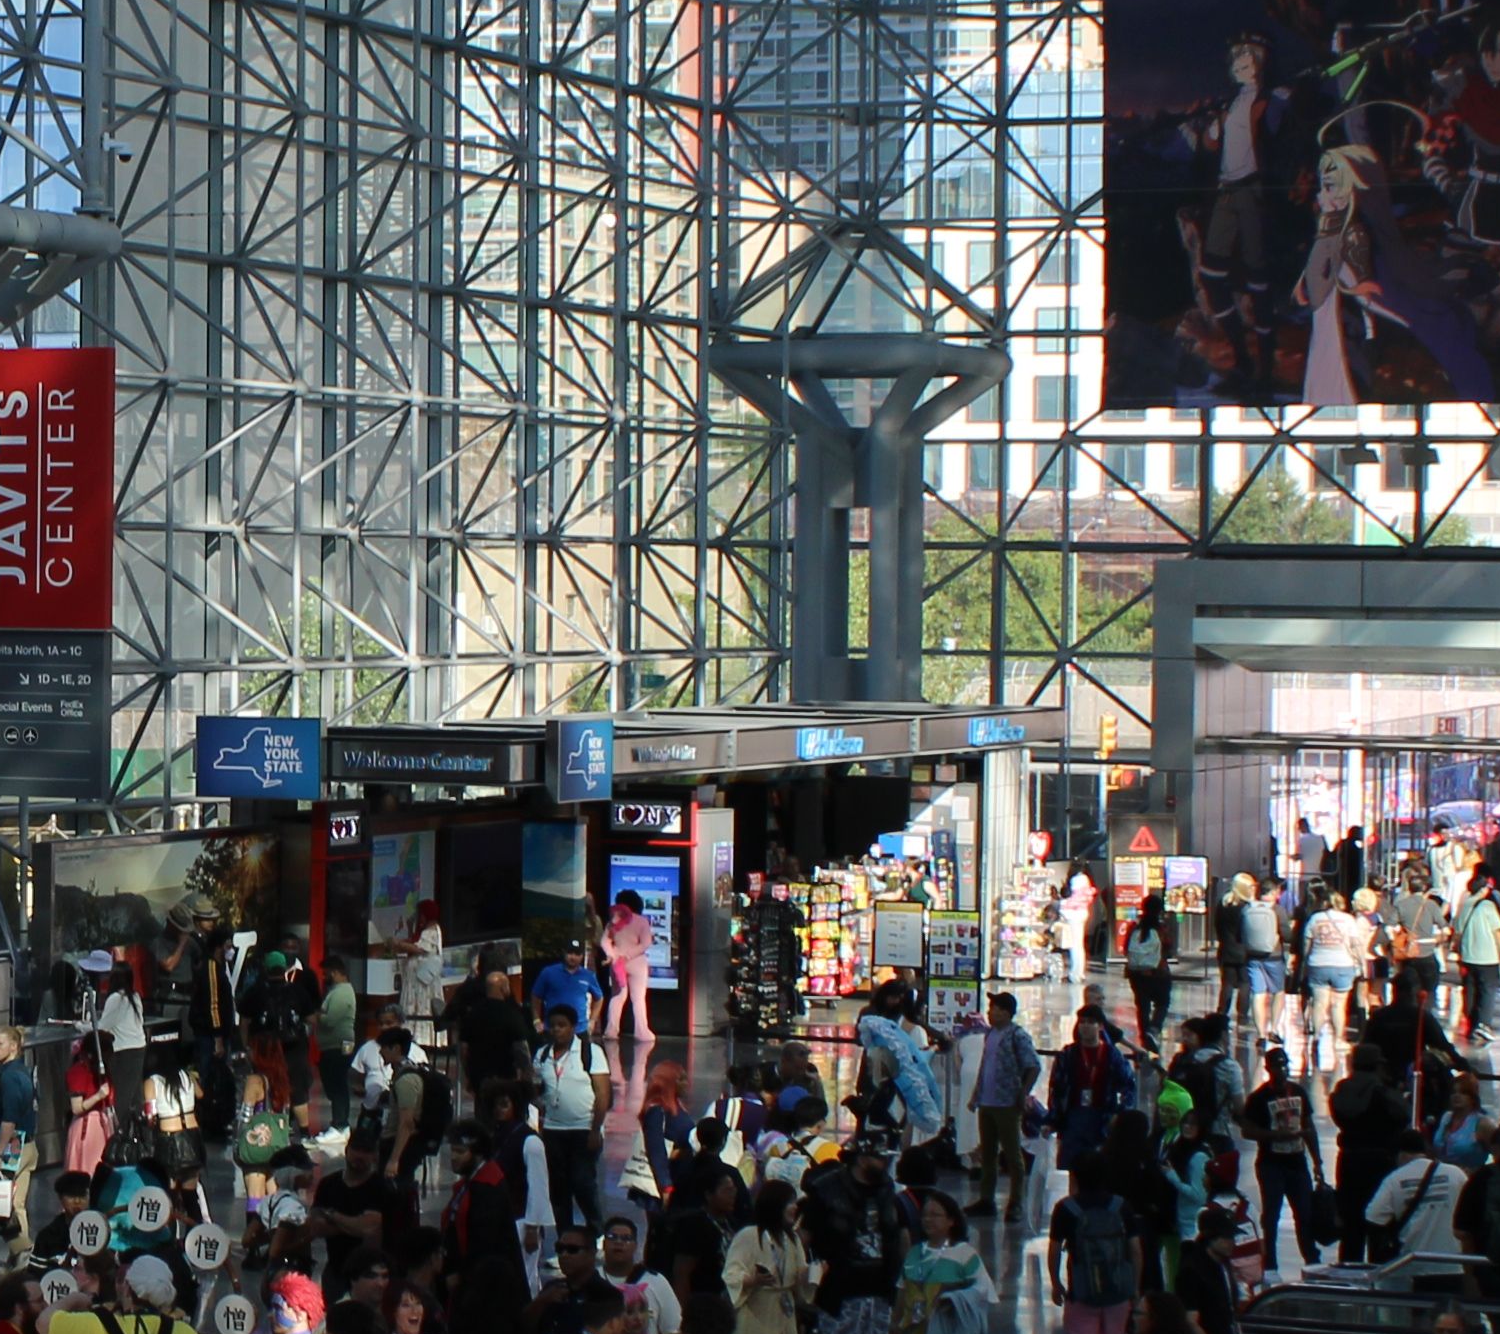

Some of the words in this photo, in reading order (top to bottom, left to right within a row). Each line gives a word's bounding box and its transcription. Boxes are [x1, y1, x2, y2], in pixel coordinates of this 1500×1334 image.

[45, 386, 76, 589] CENTER
[14, 645, 44, 657] North,
[47, 646, 59, 656] 1A
[70, 646, 82, 656] 1C
[38, 674, 50, 684] 1D
[78, 674, 92, 685] 2D
[21, 702, 53, 713] Events
[60, 700, 84, 709] FedEx
[60, 708, 84, 718] Office
[264, 734, 294, 748] NEW
[588, 736, 602, 749] NEW
[264, 748, 300, 760] YORK
[588, 749, 606, 761] YORK
[264, 761, 303, 773] STATE
[342, 750, 430, 769] Welcome
[430, 752, 492, 773] Center
[588, 762, 606, 775] STATE
